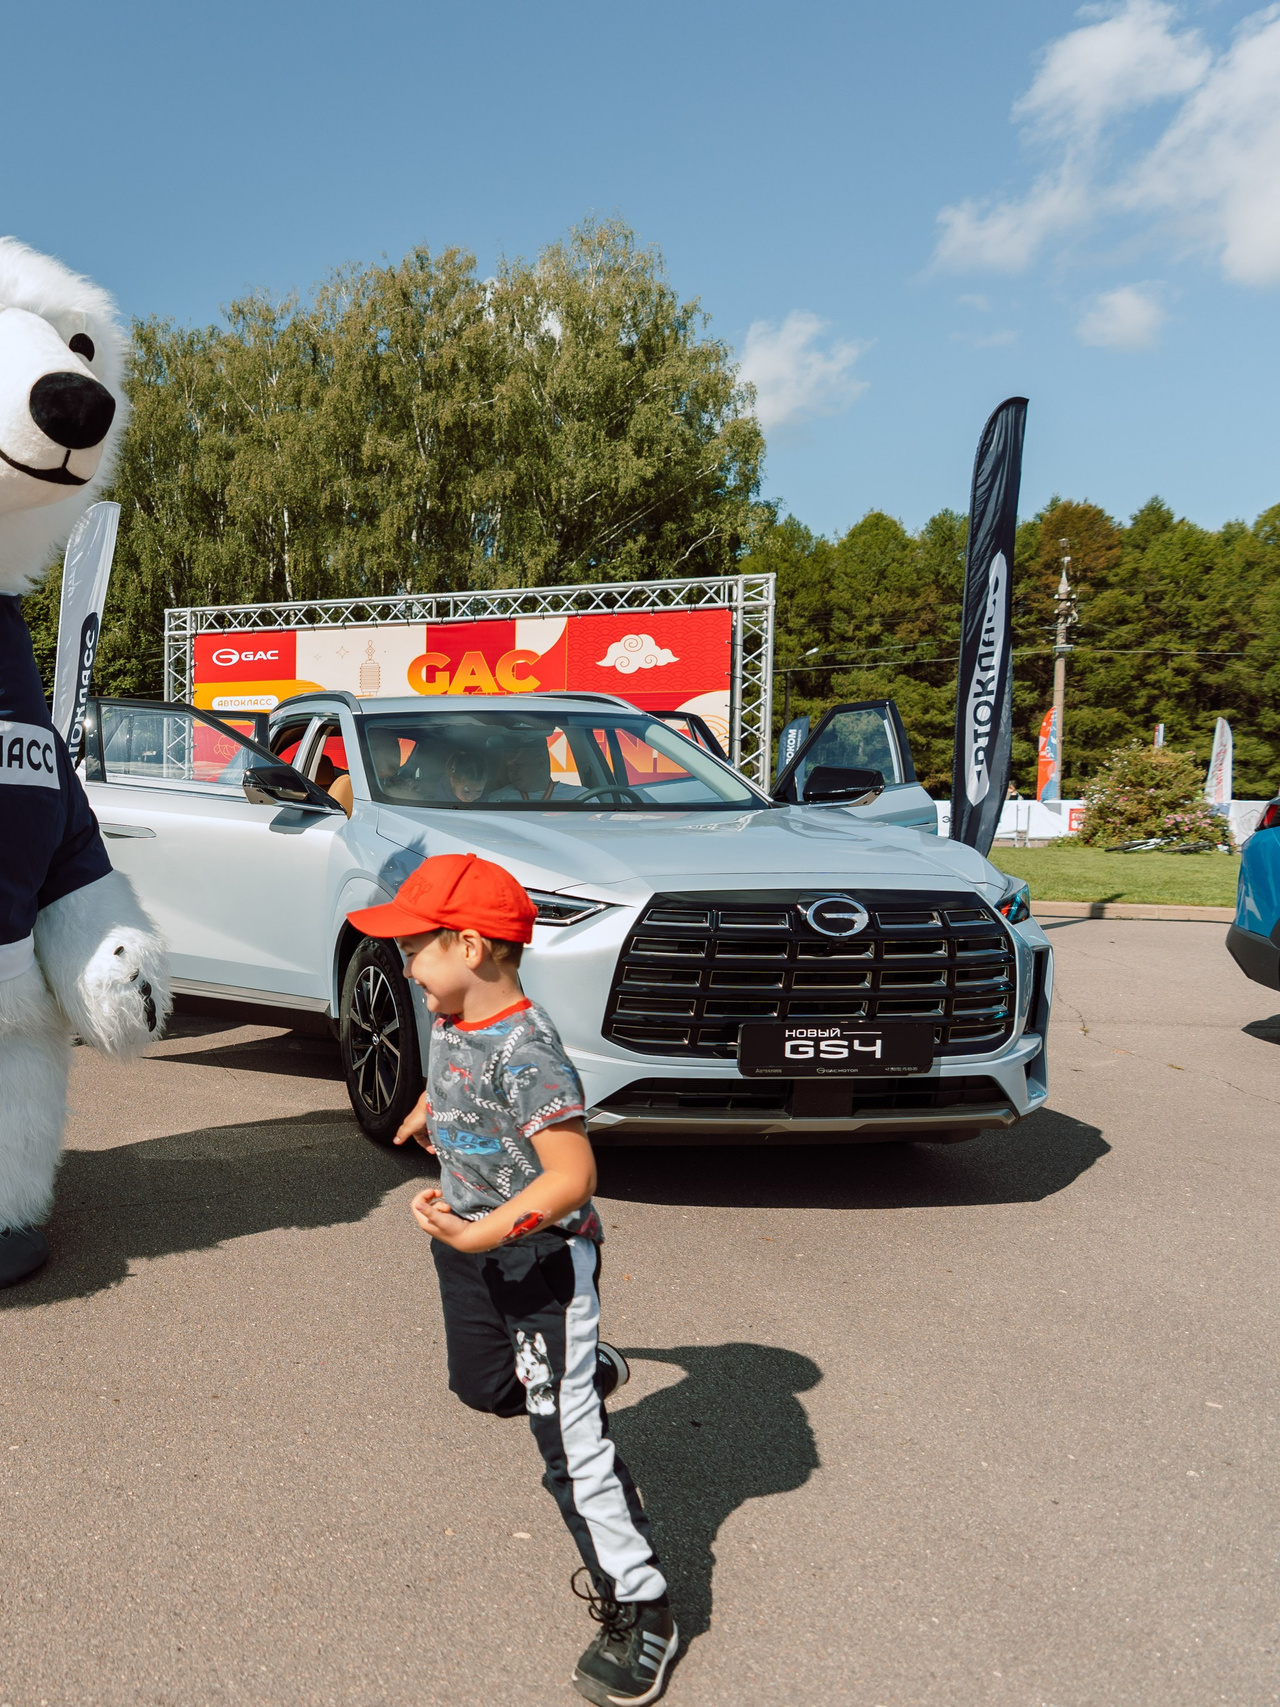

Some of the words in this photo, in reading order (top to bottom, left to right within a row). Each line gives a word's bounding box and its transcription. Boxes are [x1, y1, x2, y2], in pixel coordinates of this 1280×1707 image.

[241, 650, 279, 661] GAC
[407, 649, 541, 696] GAC
[217, 698, 272, 707] АВТОКЛАСС
[785, 1028, 840, 1037] НОВЫЙ
[784, 1039, 882, 1059] GS4
